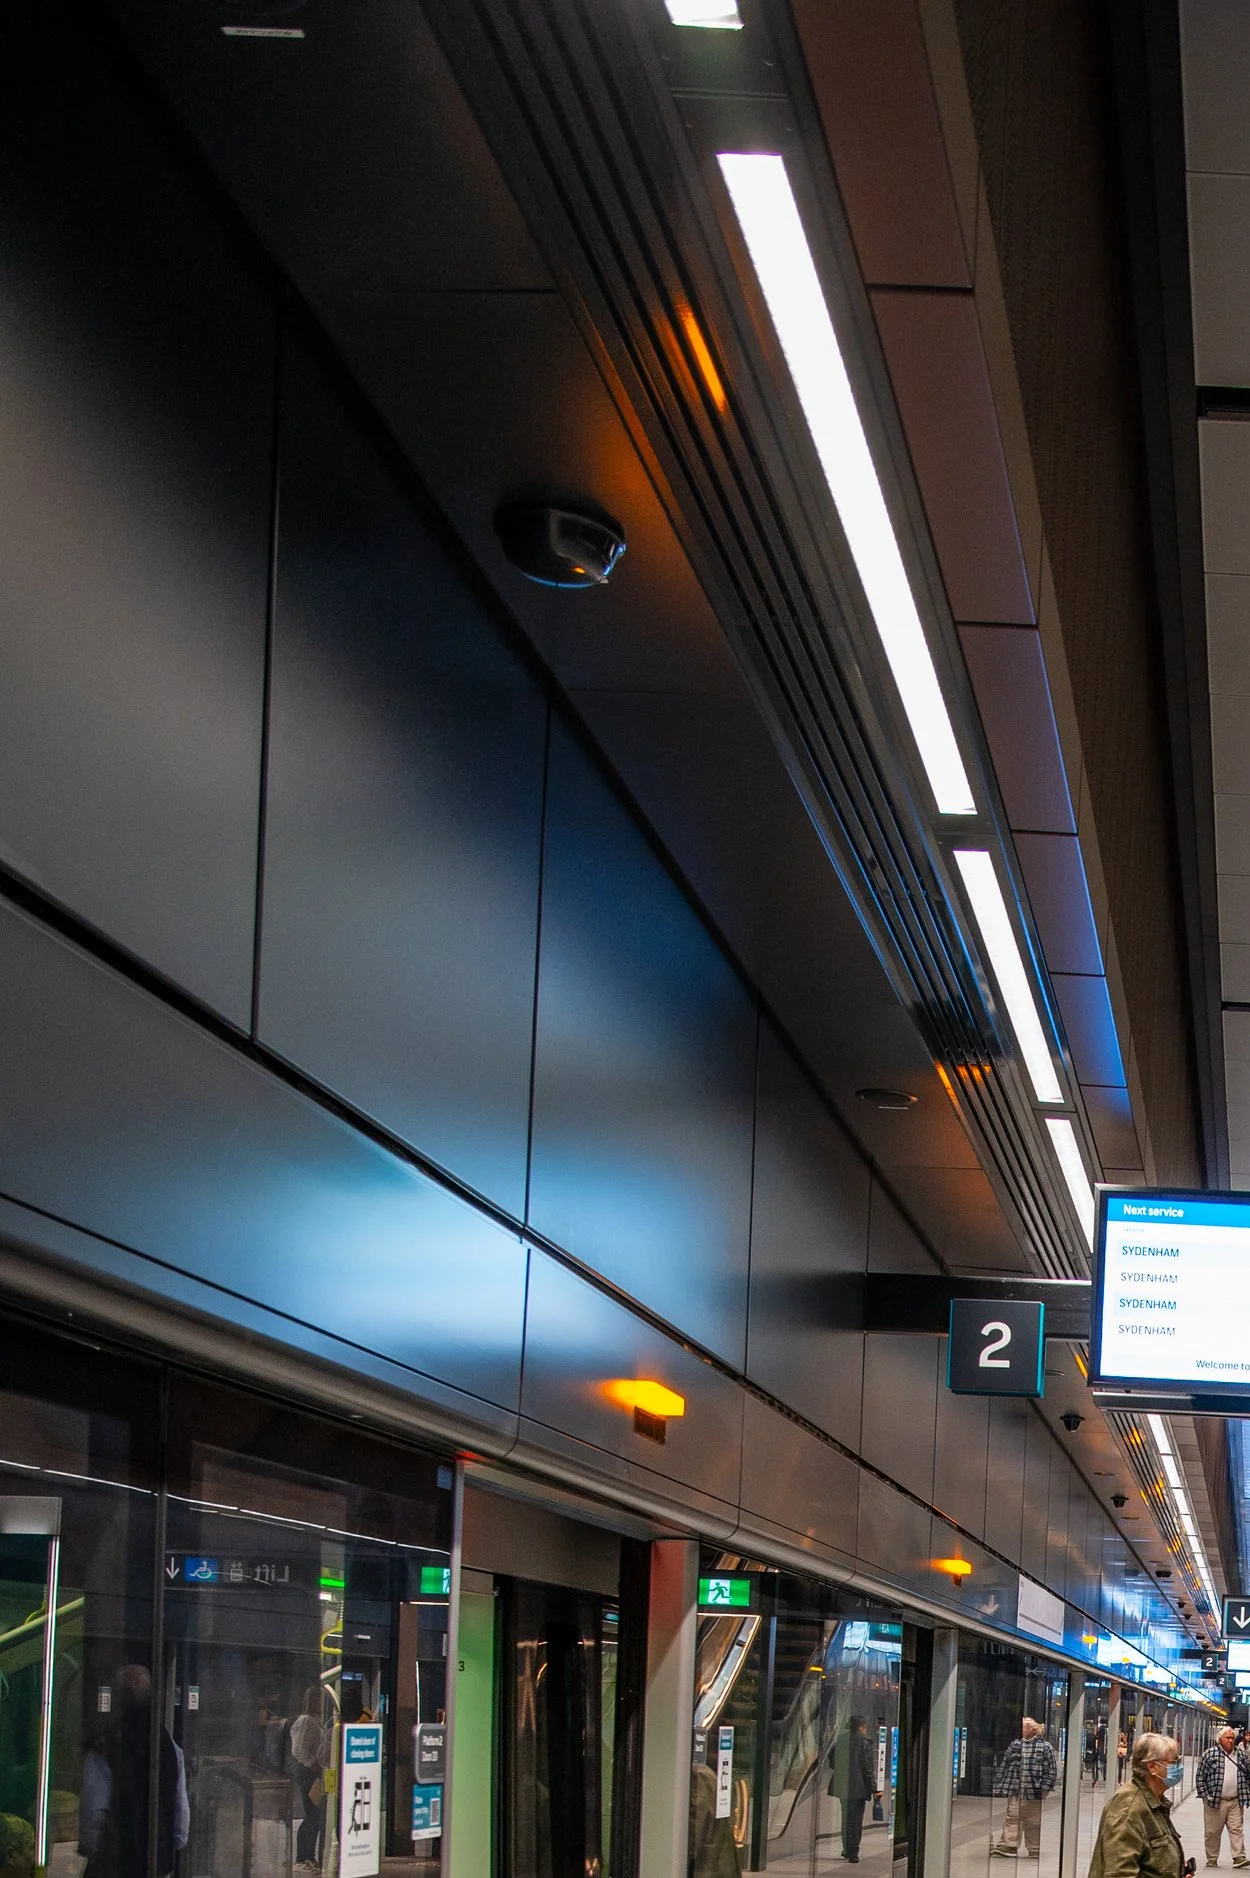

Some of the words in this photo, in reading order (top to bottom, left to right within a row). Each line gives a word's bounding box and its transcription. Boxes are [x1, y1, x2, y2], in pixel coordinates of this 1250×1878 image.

[1123, 1204, 1147, 1216] Next
[1148, 1206, 1184, 1218] service
[1122, 1245, 1179, 1258] SYDENHAM
[1120, 1271, 1178, 1284] SYDENHAM
[1119, 1298, 1177, 1310] SYDENHAM
[1118, 1324, 1176, 1336] SYDENHAM
[979, 1321, 1011, 1368] 2
[1196, 1359, 1239, 1371] Welcome
[1241, 1363, 1250, 1371] to
[1206, 1657, 1213, 1667] 2
[1219, 1677, 1225, 1685] 2
